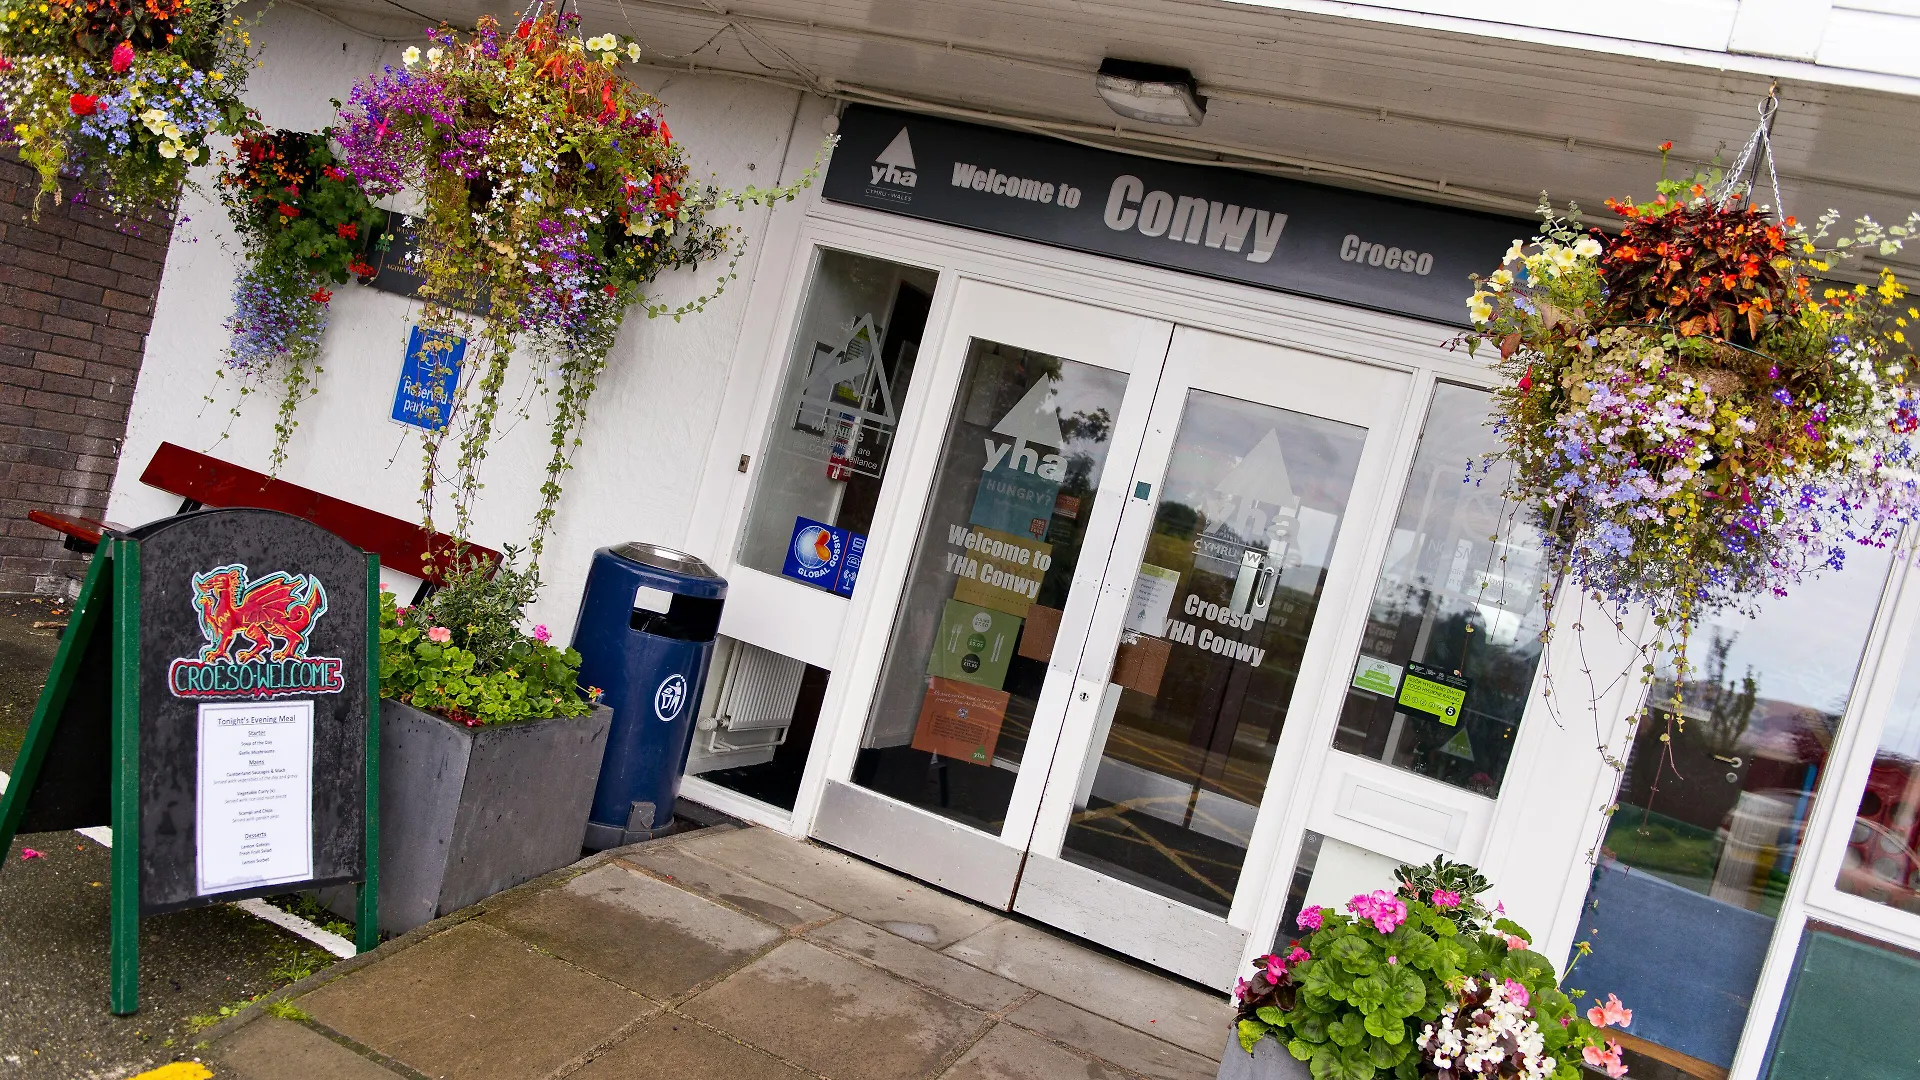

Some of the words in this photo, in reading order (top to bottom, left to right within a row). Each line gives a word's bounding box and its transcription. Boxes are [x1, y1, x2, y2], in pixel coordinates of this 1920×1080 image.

[870, 165, 918, 188] yha
[951, 162, 1055, 204] Welcome
[1056, 183, 1082, 209] to
[865, 188, 887, 198] CYMRU
[891, 192, 912, 202] WALES
[1103, 174, 1289, 264] Conwy
[1340, 234, 1434, 276] Croeso
[403, 400, 441, 421] parki
[799, 430, 821, 443] These
[858, 448, 871, 456] are
[812, 420, 864, 442] WARNING
[810, 444, 832, 456] CCTV
[833, 452, 878, 469] surveillance
[982, 437, 1069, 484] yha
[986, 480, 1051, 506] HUNGRY?
[797, 567, 830, 578] GLOBAL
[829, 534, 841, 567] GOSSIP
[948, 524, 1030, 565] Welcome
[1034, 550, 1052, 572] to
[1193, 539, 1238, 558] CYMRU
[946, 553, 976, 580] YHA
[980, 563, 1041, 599] Conwy
[1184, 594, 1255, 631] Croeso
[1161, 617, 1196, 646] YHA
[1198, 629, 1266, 668] Conwy
[218, 717, 249, 726] Tonight's
[251, 716, 277, 724] Evening
[1447, 707, 1454, 716] 5
[244, 832, 266, 840] Desserts
